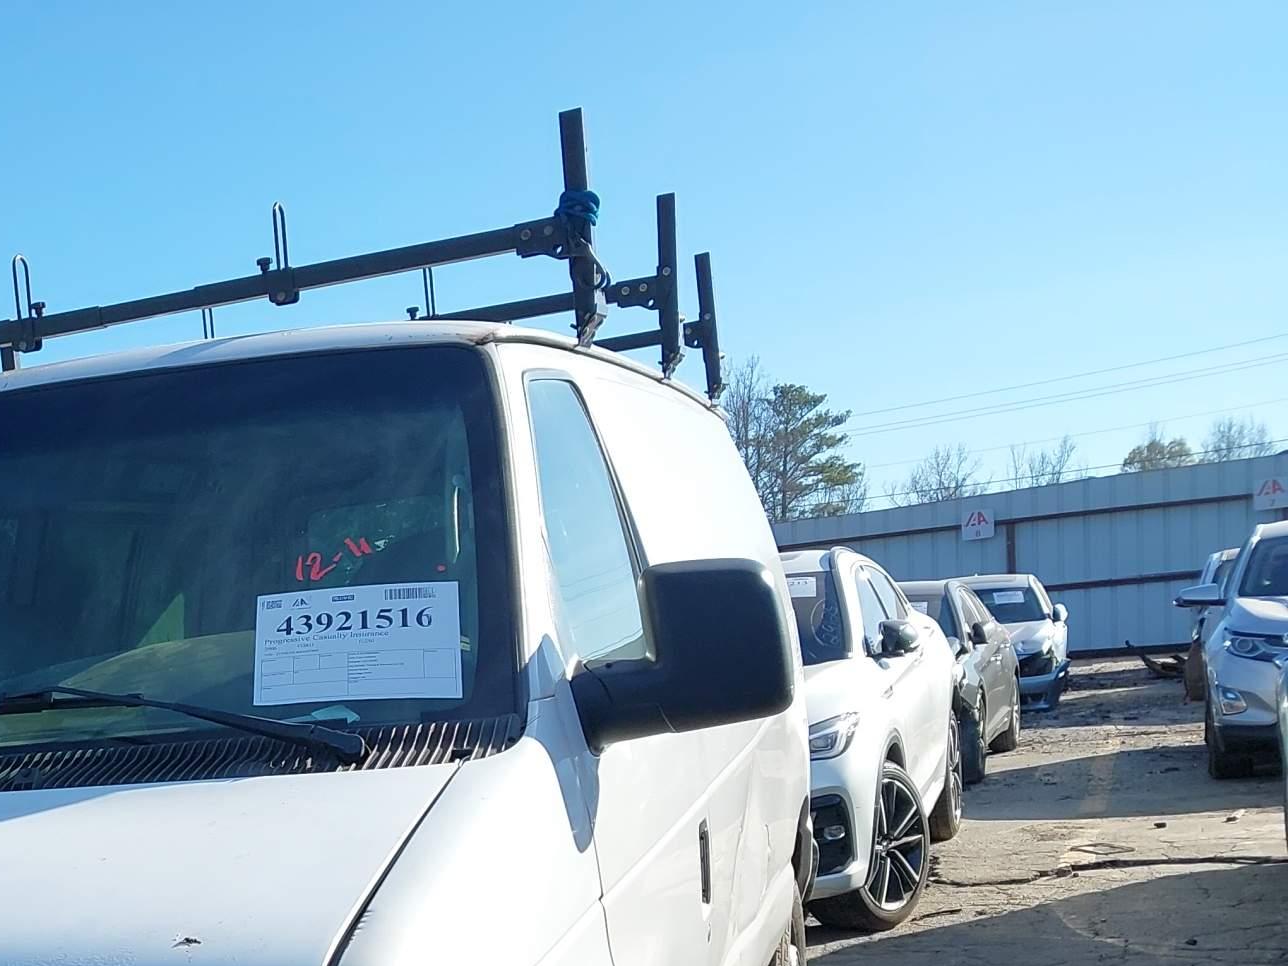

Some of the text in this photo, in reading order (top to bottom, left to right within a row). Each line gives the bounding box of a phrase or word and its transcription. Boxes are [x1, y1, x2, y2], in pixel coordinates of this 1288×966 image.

[276, 606, 433, 636] 43921516
[264, 635, 311, 646] Progressive
[312, 631, 347, 641] Casualty
[350, 629, 389, 639] Insurance
